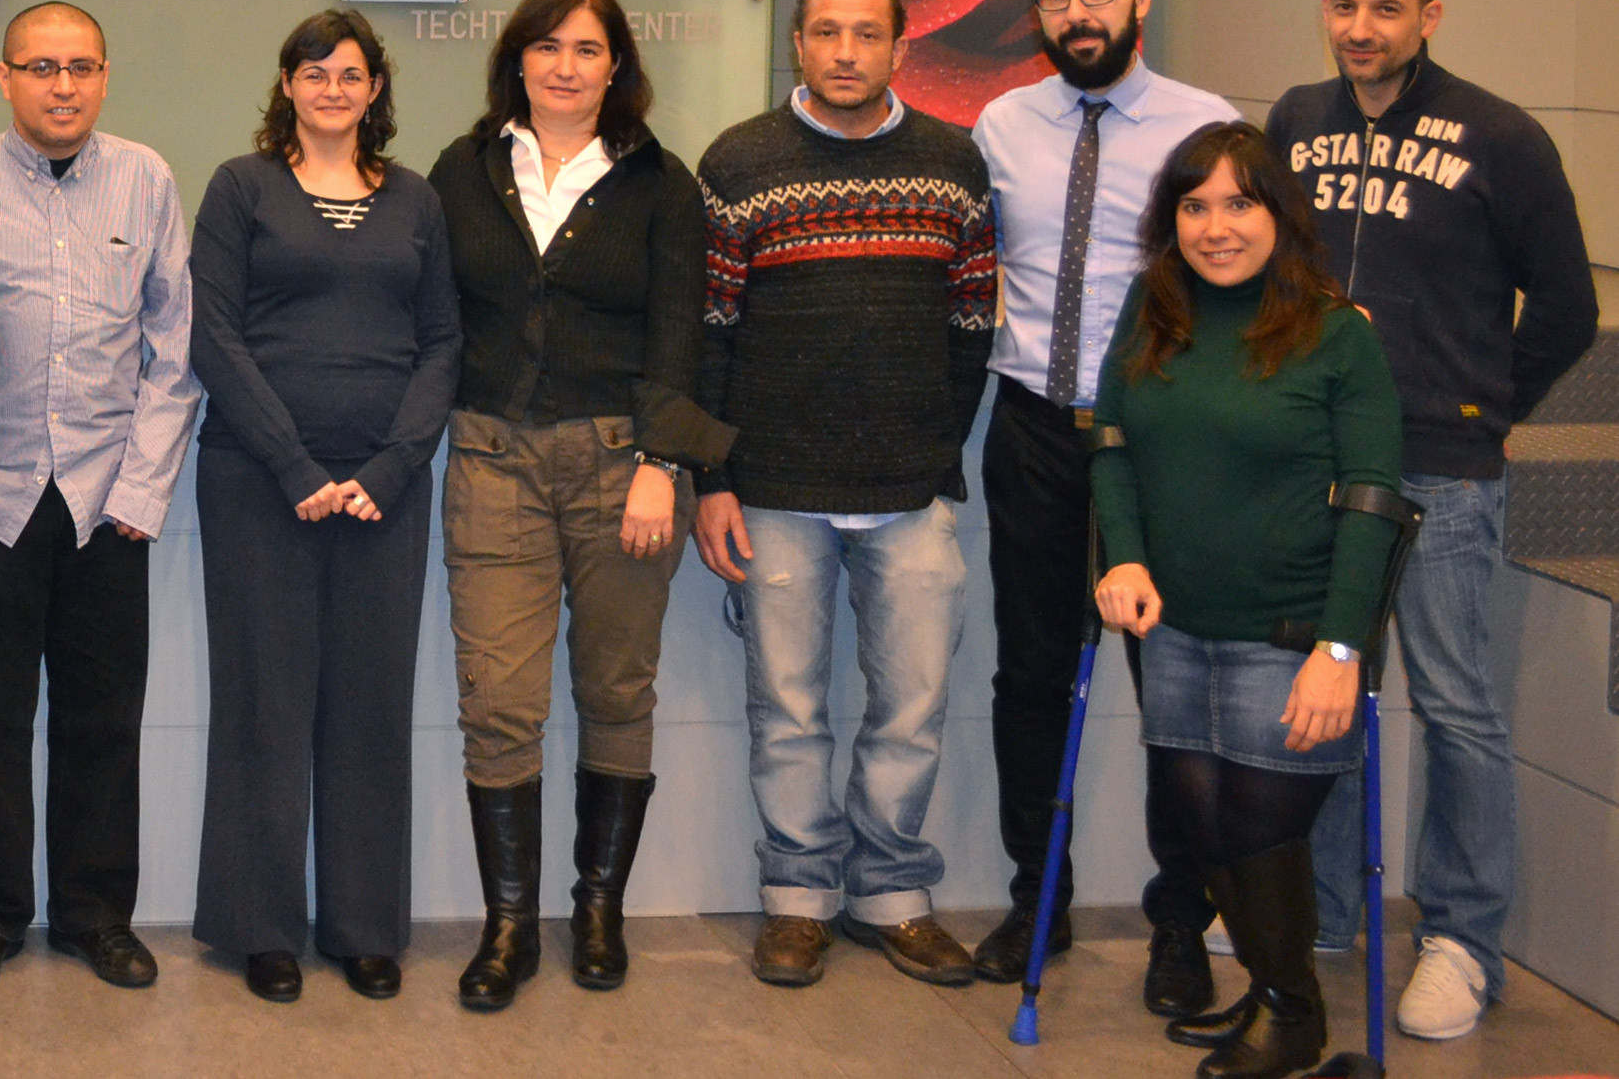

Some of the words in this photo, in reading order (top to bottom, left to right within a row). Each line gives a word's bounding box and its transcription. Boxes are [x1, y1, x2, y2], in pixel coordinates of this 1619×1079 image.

[411, 9, 509, 40] TECHT
[625, 11, 722, 42] ENTER
[1414, 115, 1464, 144] DNM
[1394, 138, 1471, 191] RAW
[1313, 173, 1411, 220] 5204
